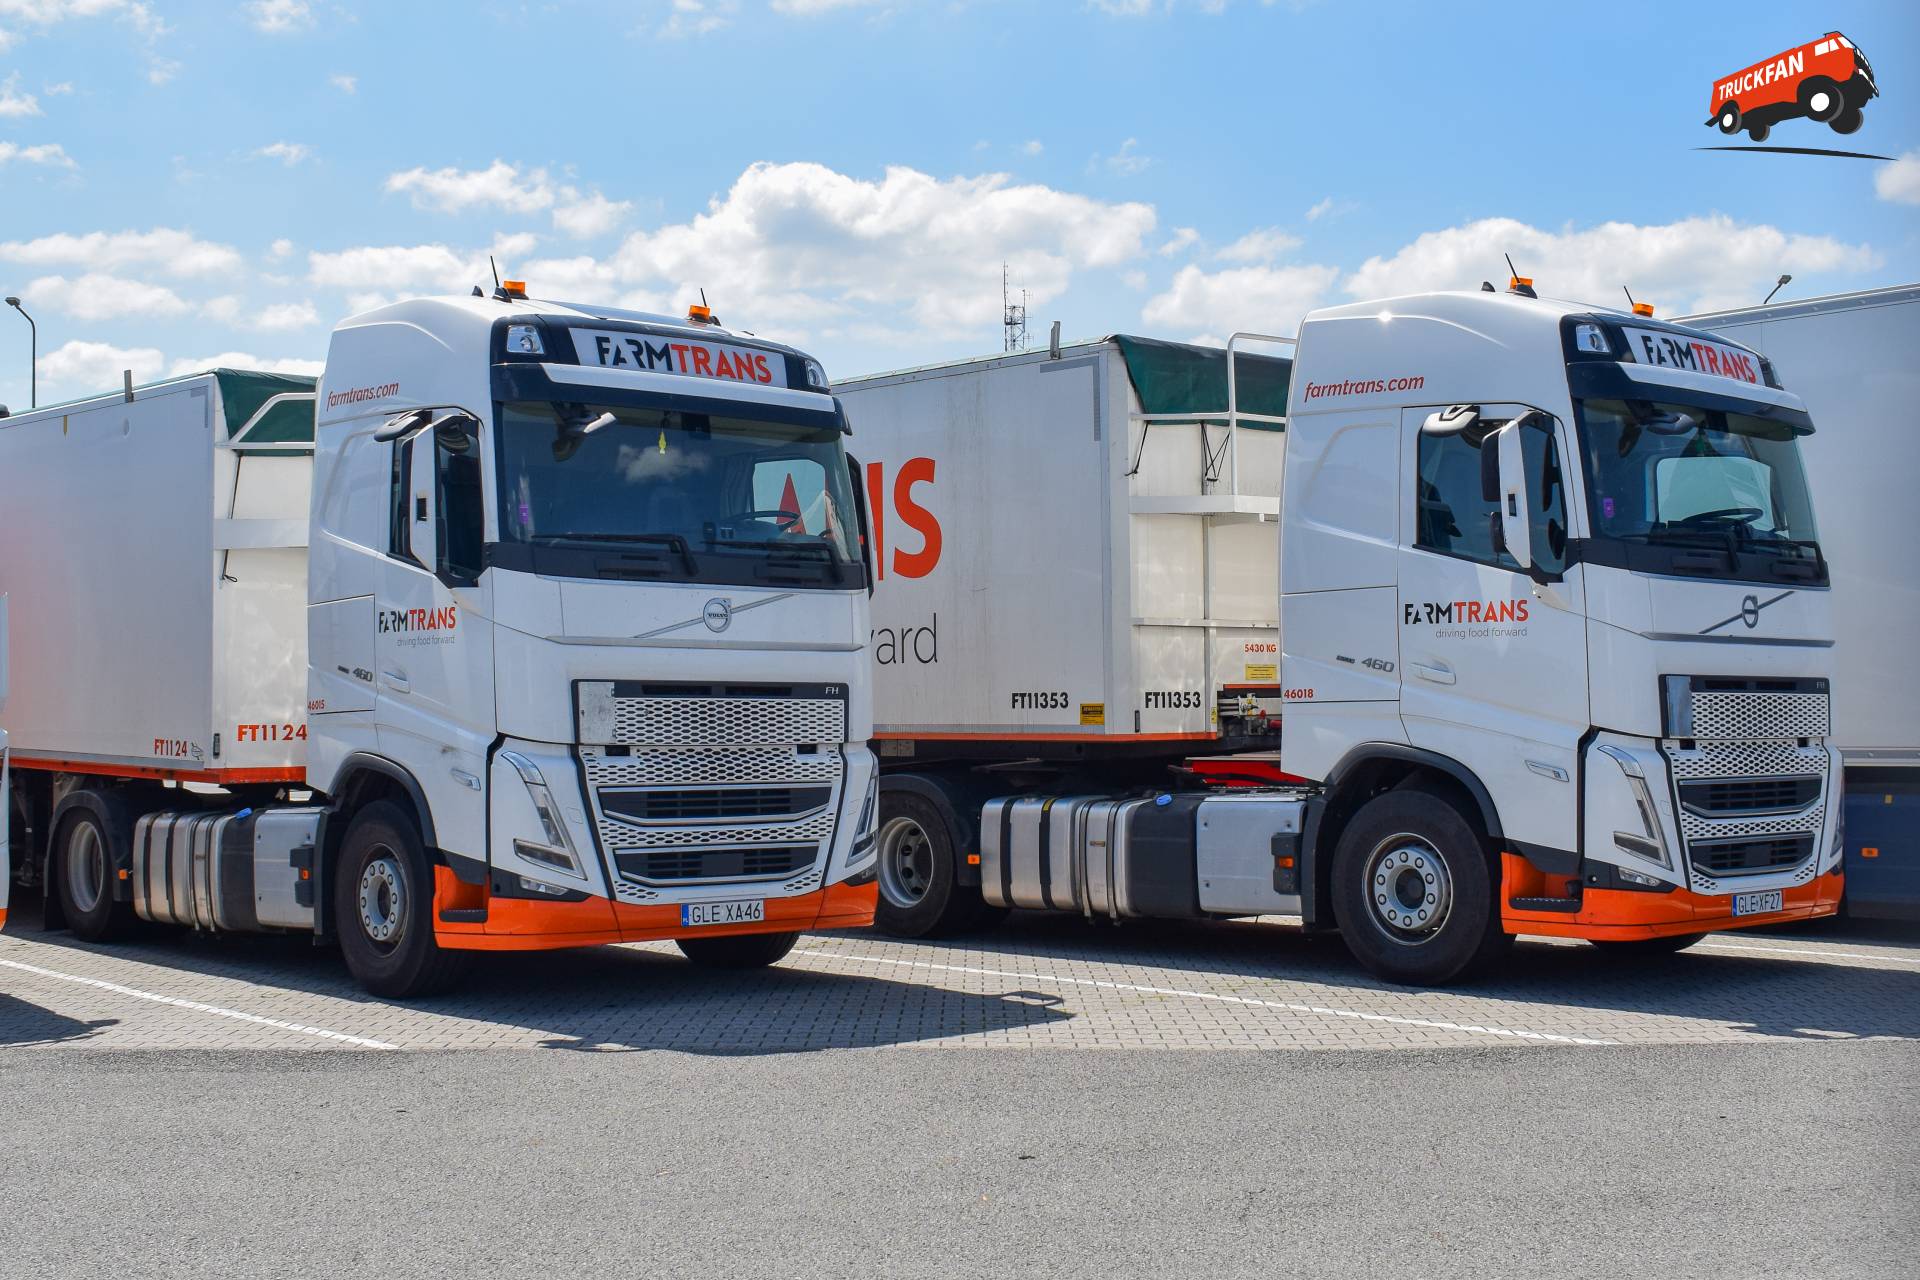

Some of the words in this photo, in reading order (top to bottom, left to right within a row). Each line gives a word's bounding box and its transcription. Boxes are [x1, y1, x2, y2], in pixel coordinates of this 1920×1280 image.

[327, 382, 399, 412] farmtrans.com
[1304, 376, 1424, 403] farmtrans.com
[1404, 600, 1529, 625] FARMTRANS
[871, 613, 938, 665] ard
[1435, 628, 1466, 640] driving
[1468, 628, 1489, 637] food
[1491, 627, 1528, 637] forward
[1244, 643, 1265, 653] 5430
[1266, 643, 1277, 653] KG
[1361, 657, 1395, 672] 460
[353, 668, 373, 682] 460
[1011, 692, 1069, 709] FT11353
[1145, 691, 1201, 709] FT11353
[1284, 688, 1314, 699] 46018
[1739, 895, 1756, 914] GLE
[1760, 892, 1780, 910] XF27
[692, 905, 720, 923] GLE
[726, 902, 761, 921] XA46
